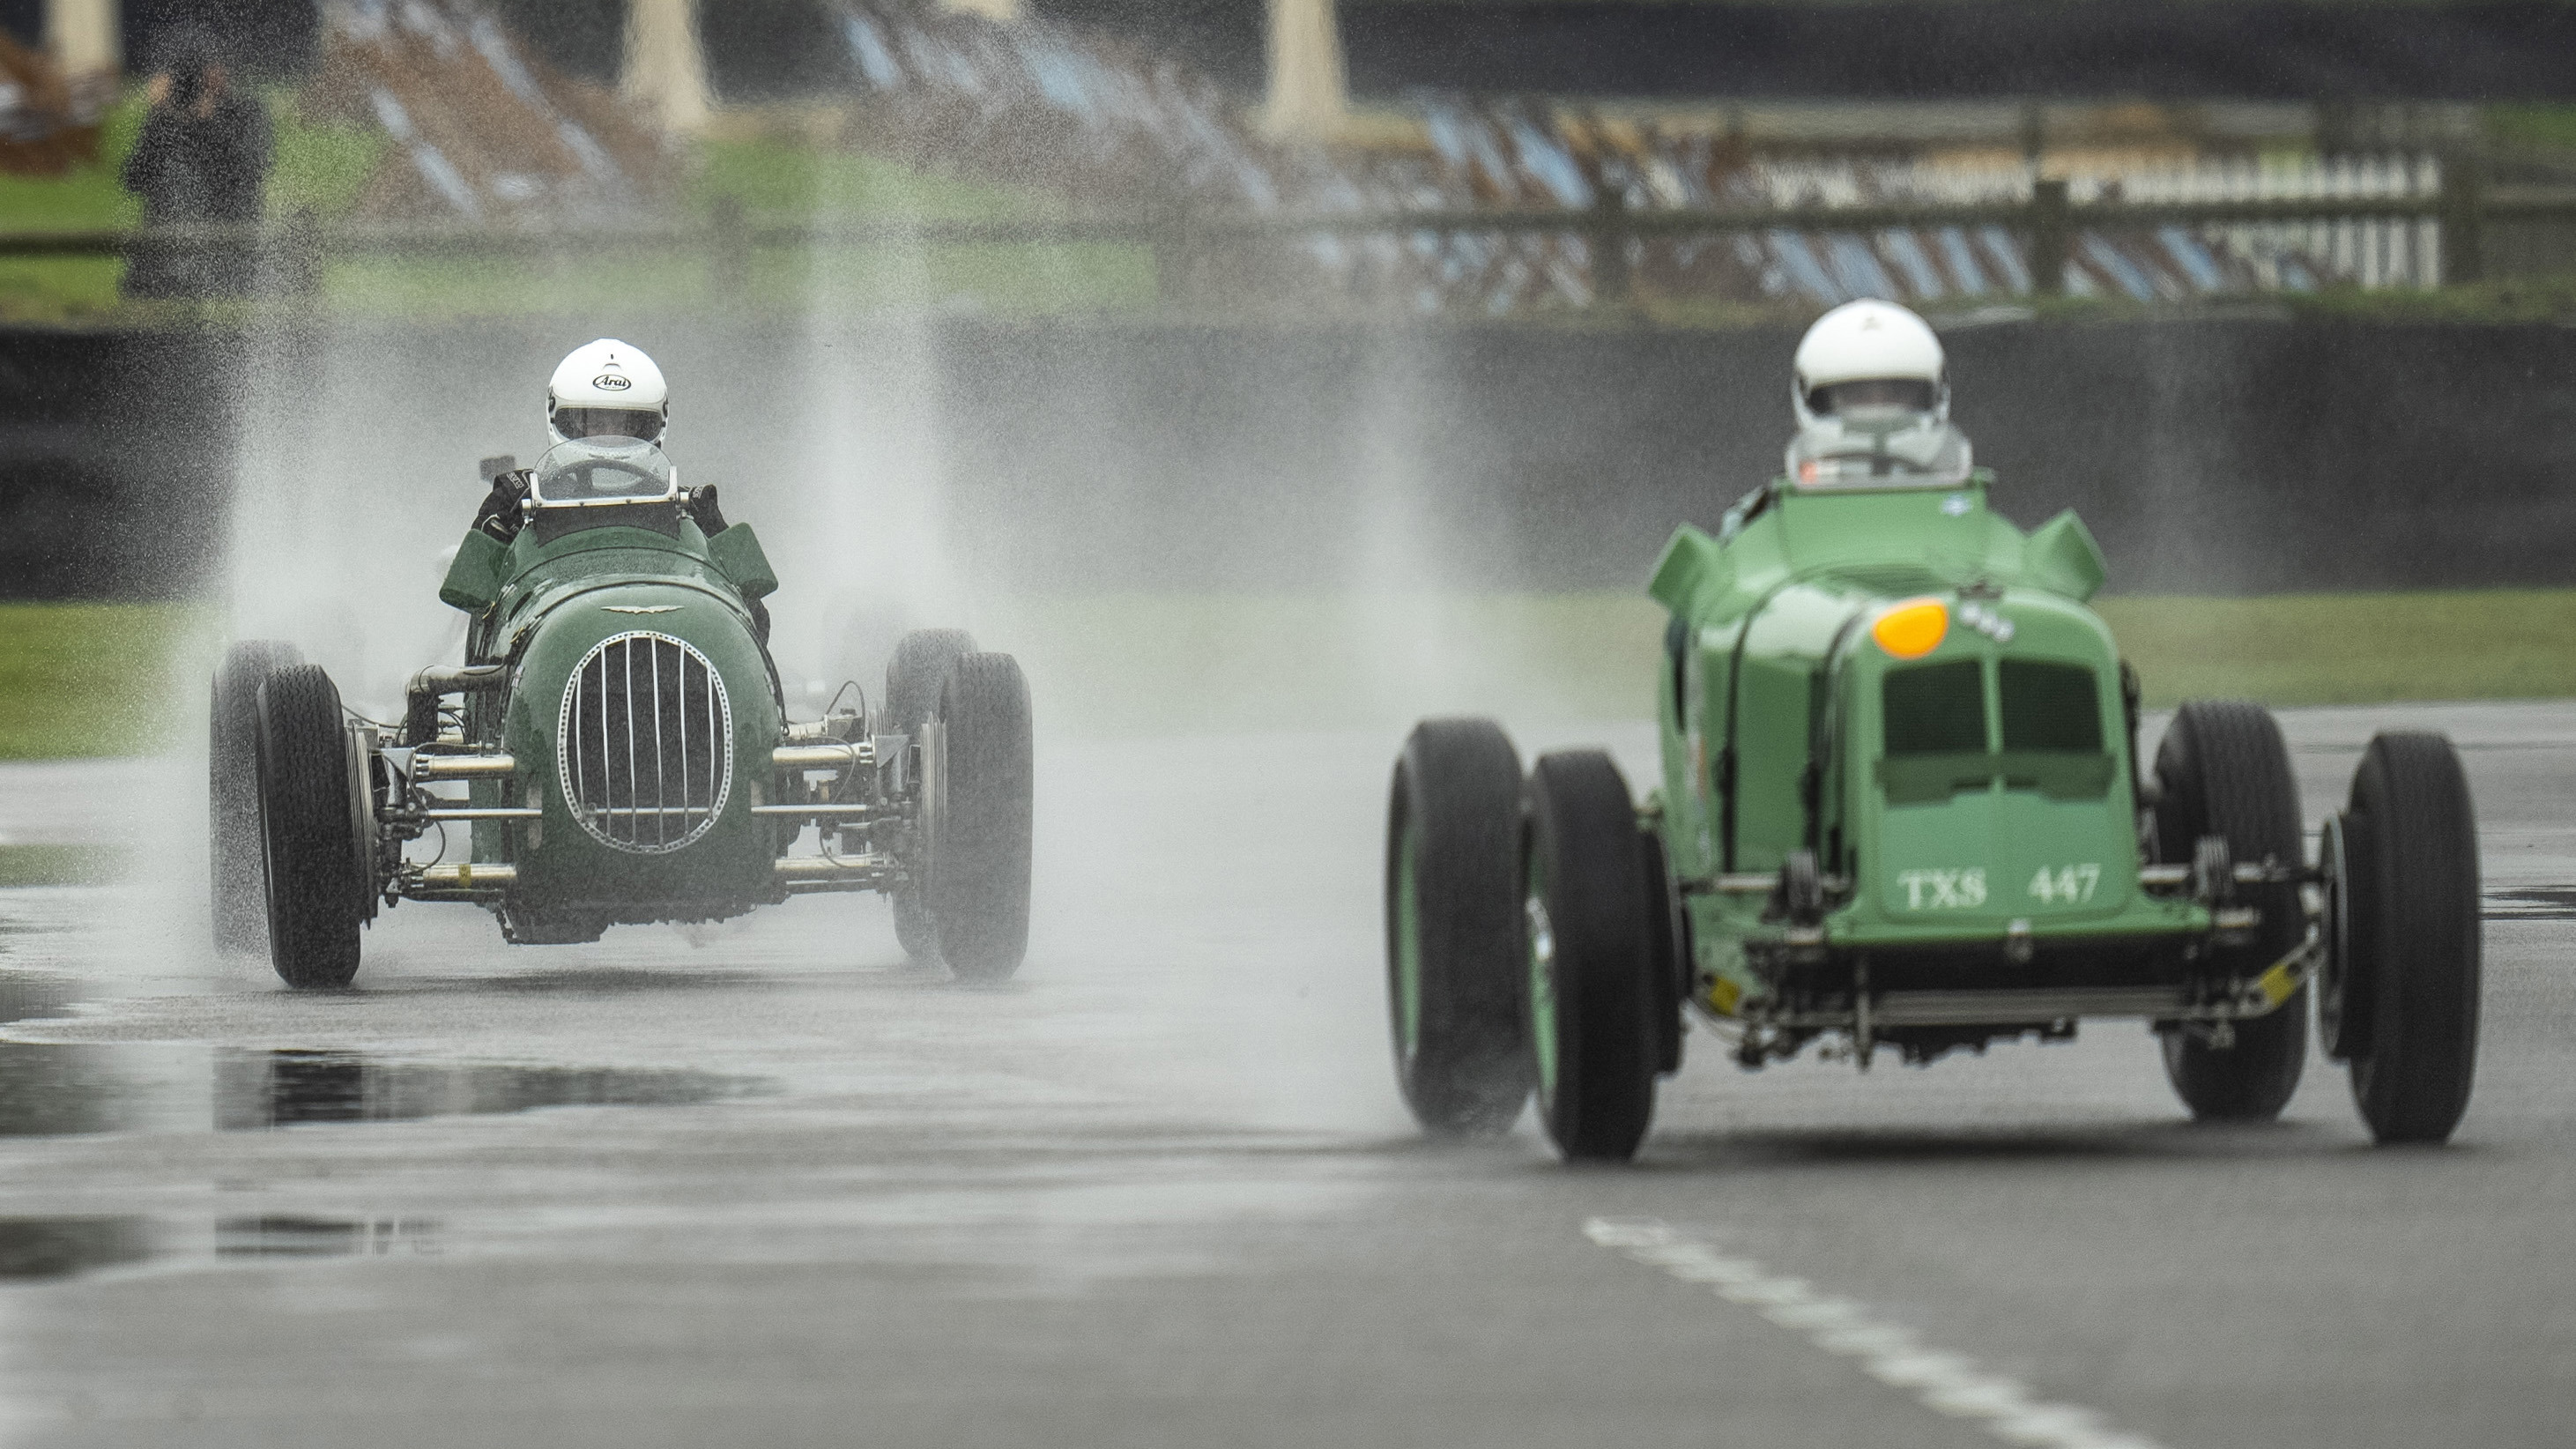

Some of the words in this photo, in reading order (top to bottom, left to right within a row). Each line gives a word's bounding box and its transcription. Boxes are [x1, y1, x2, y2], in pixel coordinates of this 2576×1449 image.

[595, 375, 627, 387] Arai
[1897, 867, 1986, 909] TXS
[2028, 863, 2101, 903] 447
